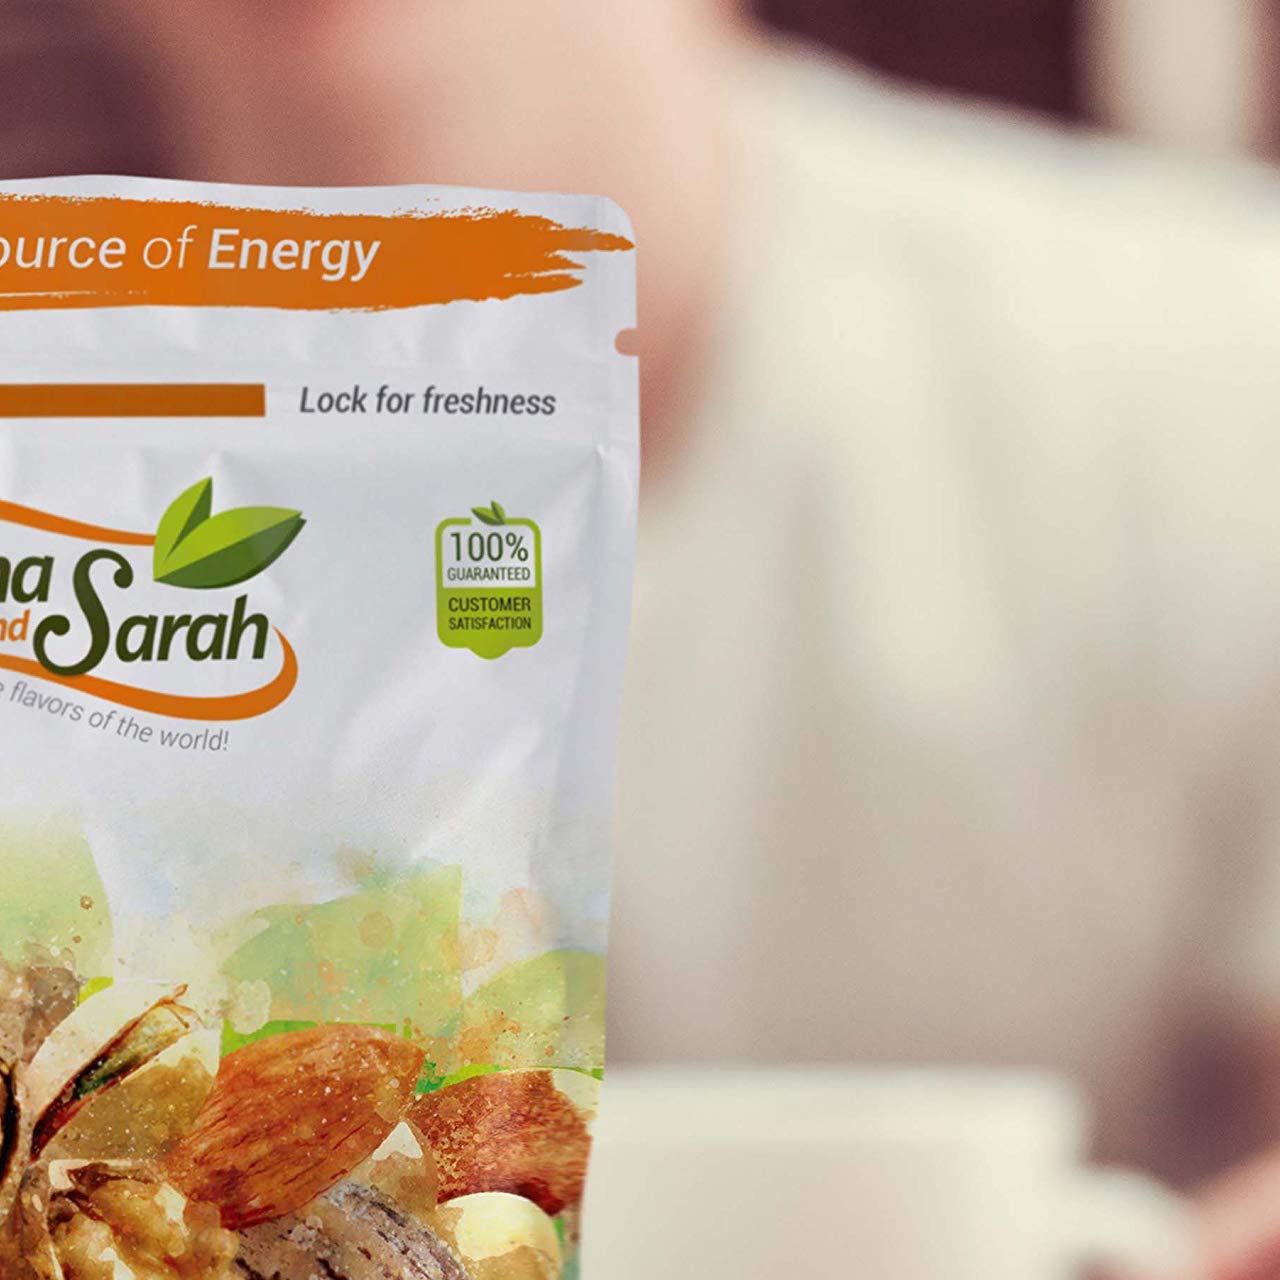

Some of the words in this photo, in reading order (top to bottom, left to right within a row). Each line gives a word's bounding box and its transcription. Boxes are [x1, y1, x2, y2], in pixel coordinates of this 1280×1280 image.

[143, 225, 197, 270] of
[208, 227, 381, 281] Energy
[300, 385, 367, 414] Lock
[375, 385, 414, 414] for
[422, 385, 556, 416] freshness
[450, 532, 529, 562] 100%
[447, 567, 531, 581] GUARANTEED
[33, 549, 269, 676] Sarah
[448, 597, 531, 612] CUSTOMER
[448, 616, 532, 630] SATISFACTION
[10, 682, 84, 721] flavors
[89, 708, 117, 732] of
[116, 715, 153, 743] the
[160, 728, 230, 752] world!
